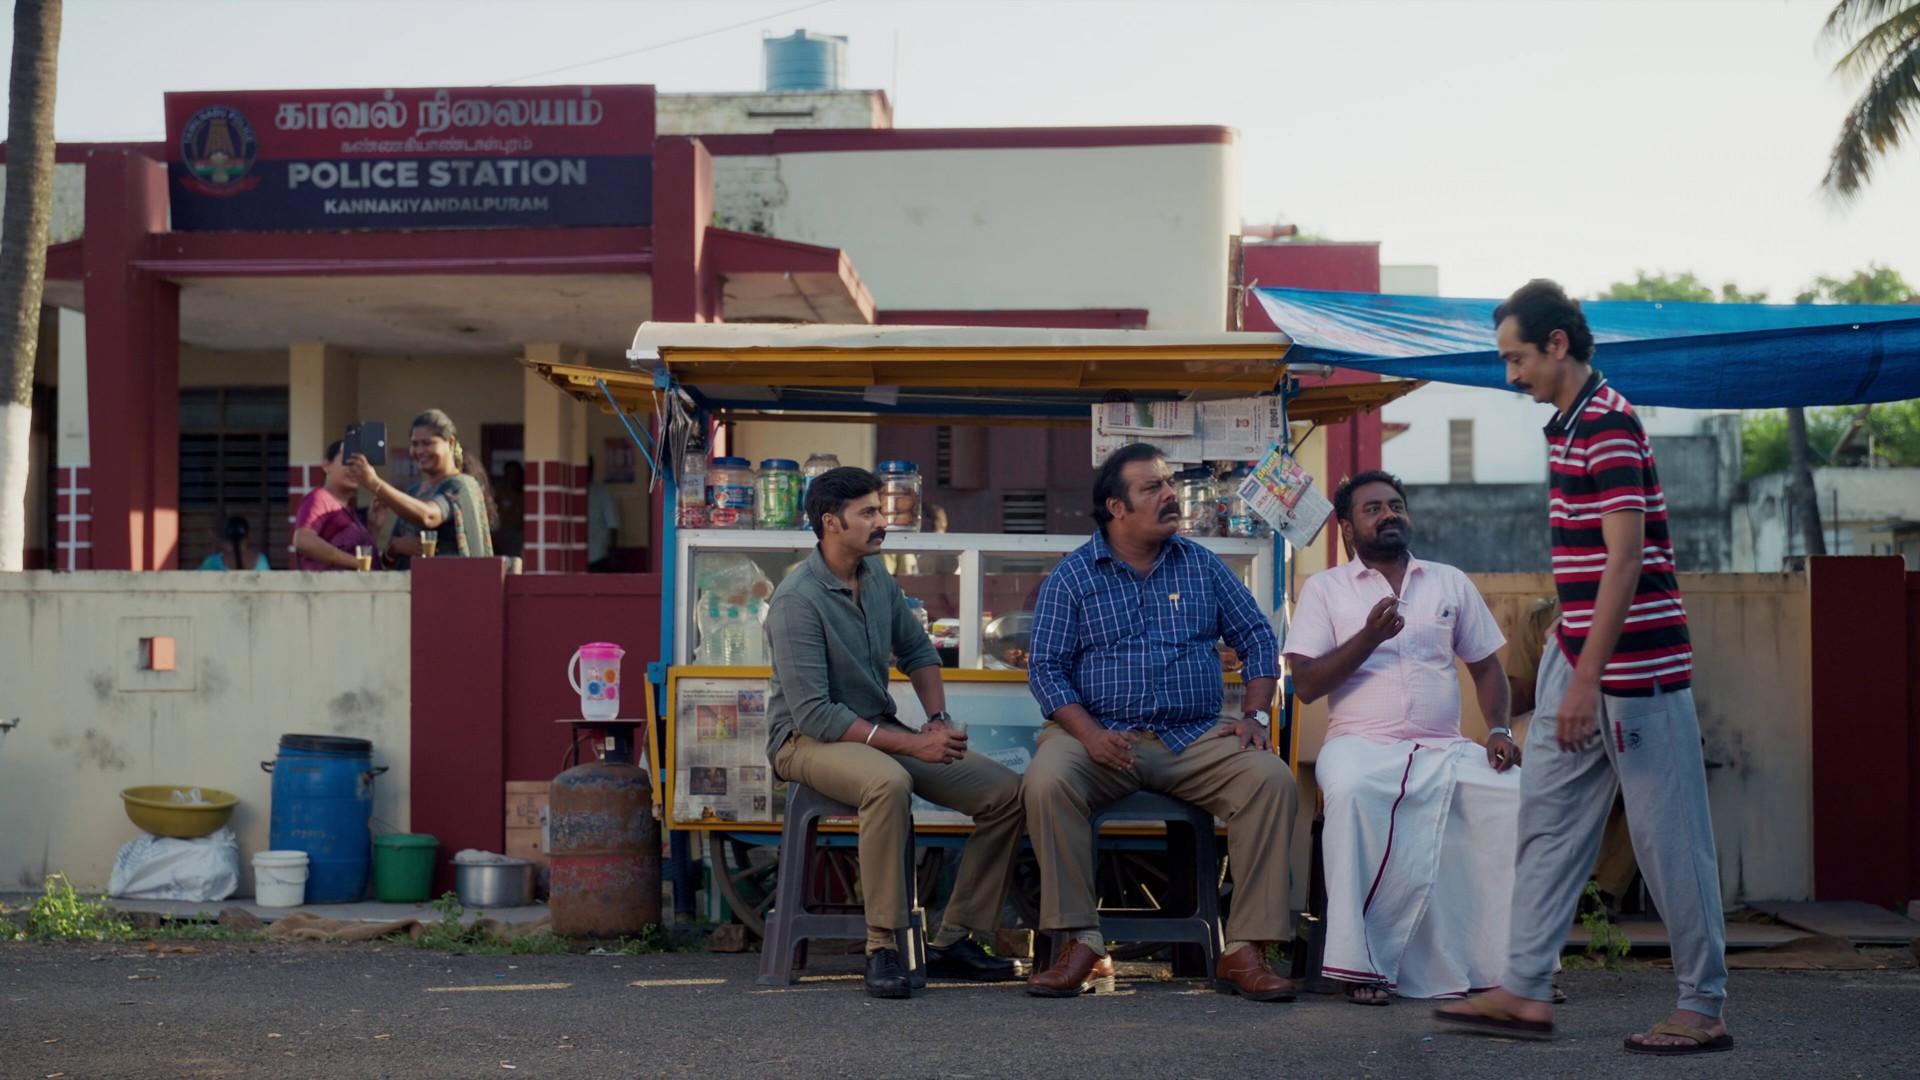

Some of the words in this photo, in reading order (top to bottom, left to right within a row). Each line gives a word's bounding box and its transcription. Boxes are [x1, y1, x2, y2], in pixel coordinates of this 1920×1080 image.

[275, 91, 407, 130] காவல்
[416, 88, 603, 136] நிலையம்
[288, 160, 419, 190] POLICE
[428, 158, 587, 188] STATION
[324, 195, 549, 215] KANNAKIYANDALPURAM
